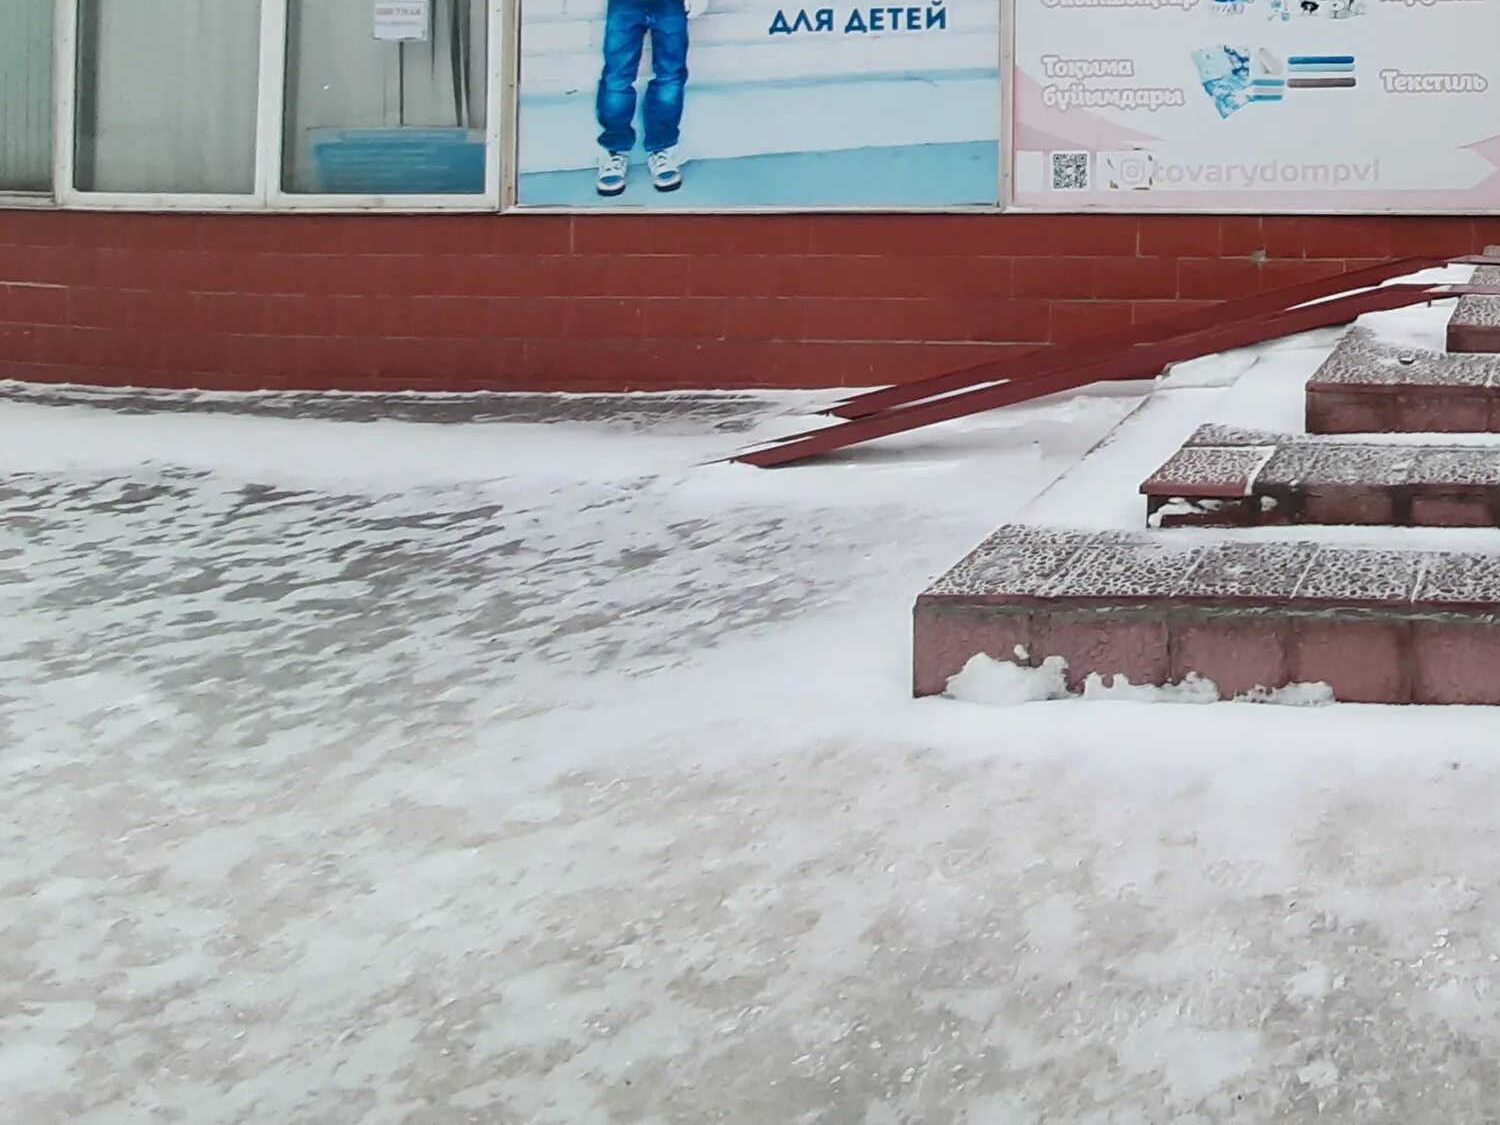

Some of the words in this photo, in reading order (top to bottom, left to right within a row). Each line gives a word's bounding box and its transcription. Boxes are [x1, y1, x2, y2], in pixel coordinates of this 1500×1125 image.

[769, 9, 834, 36] ДЛЯ
[844, 0, 946, 35] ДЕТЕЙ
[1379, 69, 1488, 95] Текстиль
